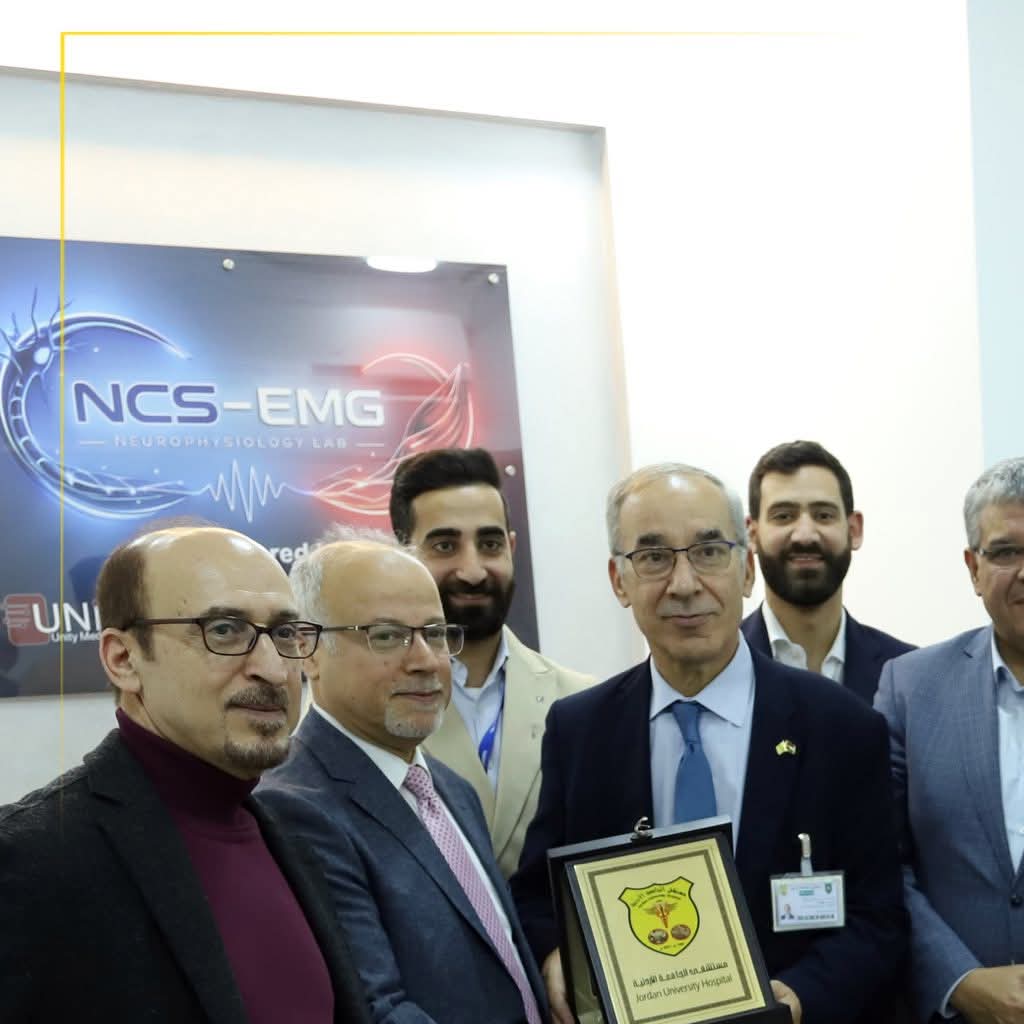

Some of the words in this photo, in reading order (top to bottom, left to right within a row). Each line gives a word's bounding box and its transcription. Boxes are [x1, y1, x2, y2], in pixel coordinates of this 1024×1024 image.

[73, 382, 386, 428] NCS-EMG
[113, 434, 303, 449] NEUROPHYSIOLOGY
[312, 437, 347, 449] LAB
[32, 601, 102, 633] UNI
[636, 991, 662, 1003] Jordan
[662, 981, 700, 996] University
[701, 974, 732, 987] Hospital
